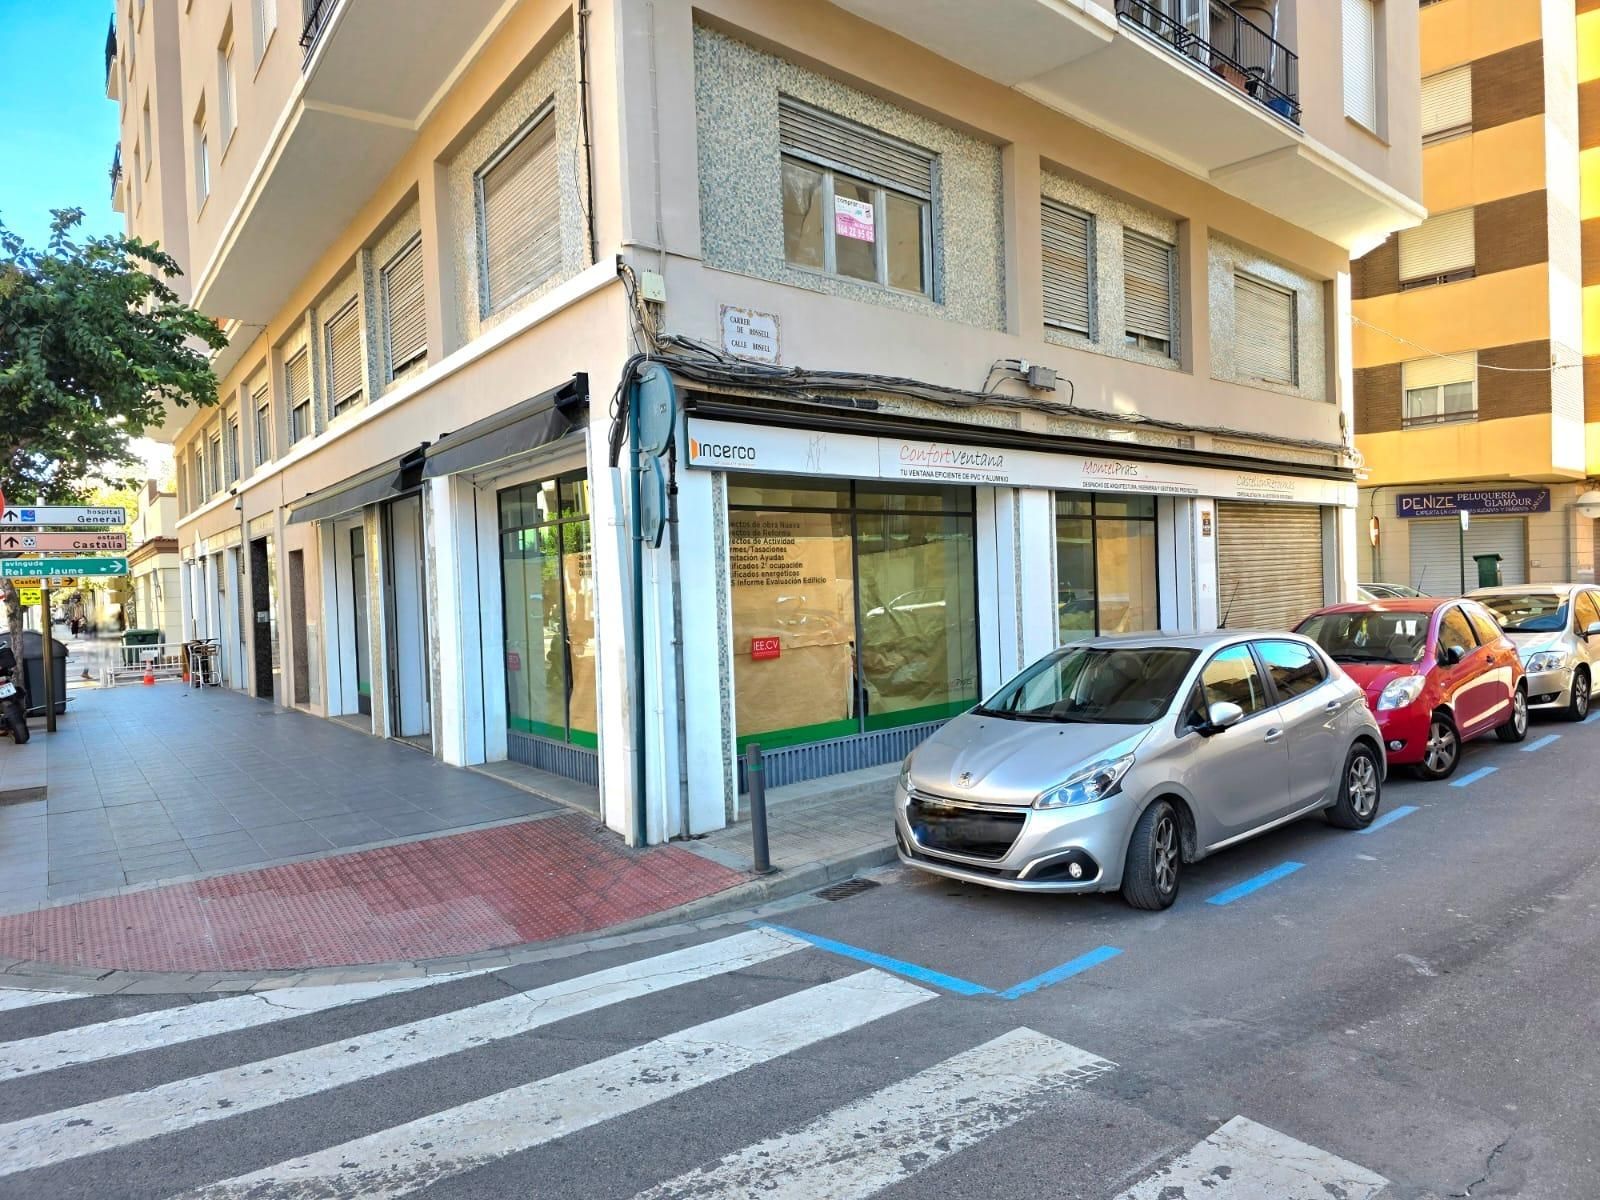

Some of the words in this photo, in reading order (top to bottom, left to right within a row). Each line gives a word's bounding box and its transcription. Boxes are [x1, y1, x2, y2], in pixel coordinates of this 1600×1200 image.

[730, 316, 750, 326] CARRER
[736, 326, 744, 334] DE
[731, 339, 748, 349] CALLE
[909, 469, 934, 478] VENTANA
[935, 471, 961, 479] EFICIENTE
[970, 473, 981, 481] PVC
[1402, 494, 1456, 510] DENIZE
[1484, 498, 1532, 507] GLAMOUR
[77, 515, 121, 523] General
[728, 521, 750, 529] ectos
[73, 541, 122, 549] Castalia
[760, 554, 785, 562] Ayudas
[5, 568, 23, 576] Rei
[49, 567, 84, 575] Jaume
[803, 576, 827, 584] Edificio
